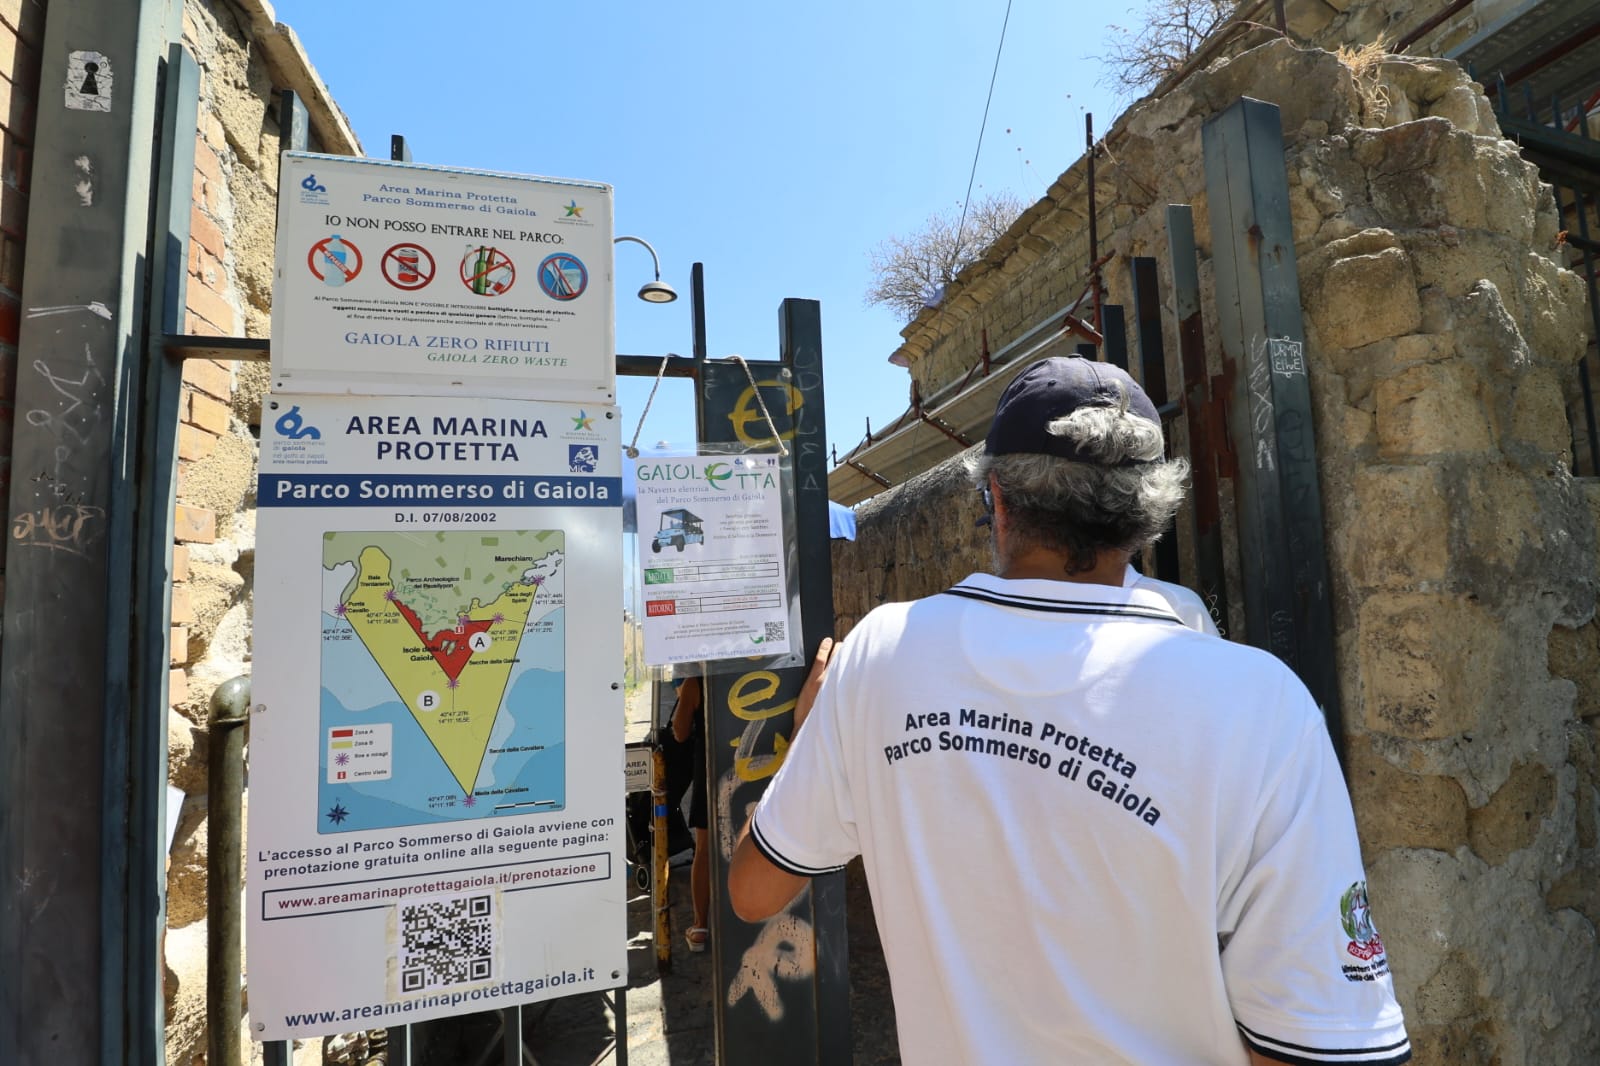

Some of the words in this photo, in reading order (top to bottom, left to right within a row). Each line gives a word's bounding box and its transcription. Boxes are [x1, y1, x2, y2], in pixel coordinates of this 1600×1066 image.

[362, 193, 401, 205] Parco
[406, 197, 475, 211] Sommerso
[480, 204, 492, 213] di
[496, 205, 537, 217] Gaiola
[379, 184, 410, 194] Area
[416, 187, 462, 199] Marina
[466, 191, 518, 204] Protetta
[325, 214, 342, 226] IO
[346, 216, 380, 228] NON
[384, 220, 426, 233] POSSO
[431, 224, 489, 238] ENTRARE
[492, 229, 516, 241] NEL
[520, 231, 564, 245] PARCO:
[344, 332, 420, 347] GAIOLA
[426, 336, 478, 350] ZERO
[484, 338, 550, 353] RIFIUTI
[428, 352, 478, 364] GAIOLA
[482, 354, 520, 366] ZERO
[524, 356, 568, 367] WASTE
[345, 416, 422, 436] AREA
[432, 416, 549, 438] MARINA
[377, 442, 520, 462] PROTETTA
[276, 480, 350, 499] Parco
[359, 480, 494, 500] Sommerso
[502, 480, 526, 500] di
[534, 480, 610, 500] Gaiola
[395, 512, 418, 524] D.I.
[422, 512, 497, 524] 07/08/2002
[474, 636, 486, 648] A
[424, 695, 434, 706] B
[904, 711, 951, 731] Area
[959, 708, 1033, 736] Marina
[1040, 722, 1138, 779] Protetta
[884, 736, 932, 765] Parco
[938, 730, 1052, 769] Sommerso
[1058, 756, 1084, 782] di
[1086, 769, 1162, 827] Gaiola
[258, 843, 332, 862] L'accesso
[336, 842, 350, 854] al
[353, 838, 396, 854] Parco
[399, 831, 473, 849] Sommerso
[476, 828, 490, 841] di
[492, 824, 536, 840] Gaiola
[538, 820, 588, 834] avviene
[591, 816, 615, 828] con
[264, 858, 360, 880] prenotazione
[364, 851, 420, 870] gratuita
[424, 846, 466, 862] online
[470, 844, 494, 857] alla
[498, 836, 558, 856] seguente
[562, 832, 610, 849] pagina:
[278, 862, 597, 910] www.areamarinaprotettagaiola.it/prenotazione
[286, 968, 596, 1028] www.areamarinaprotettagaiola.it
